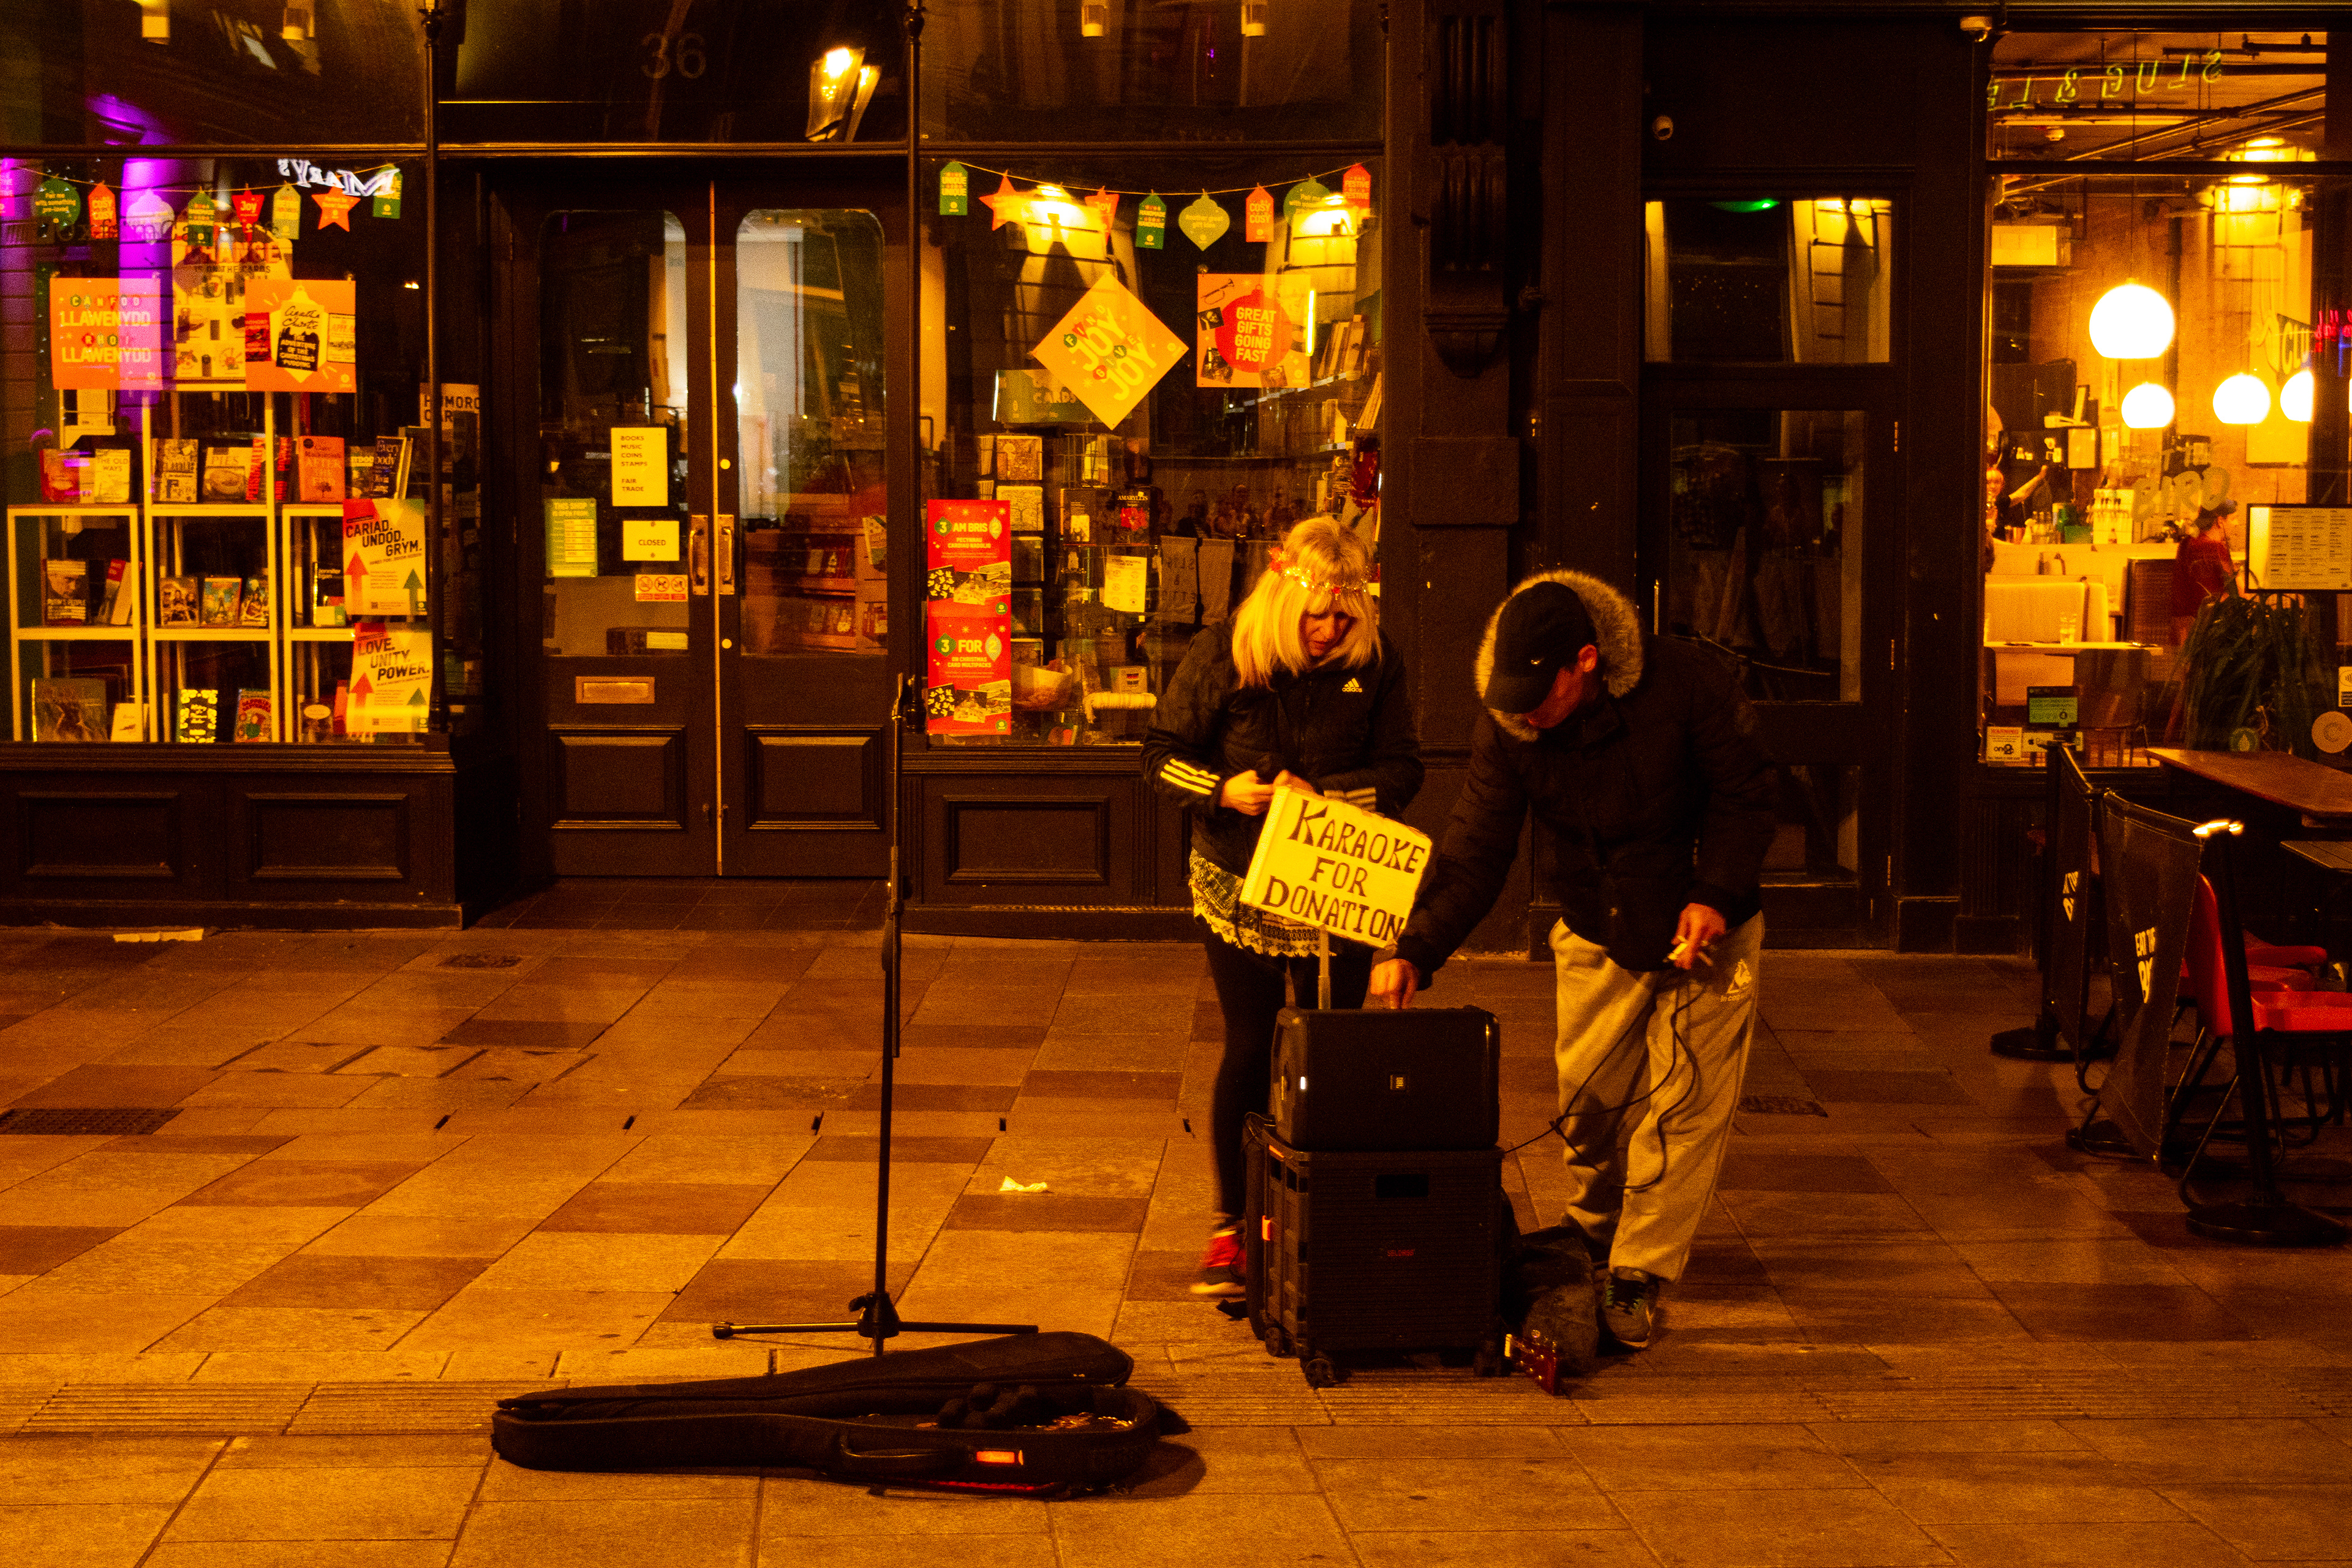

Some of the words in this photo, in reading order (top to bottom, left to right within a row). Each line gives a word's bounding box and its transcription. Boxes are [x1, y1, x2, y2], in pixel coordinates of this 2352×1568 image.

[641, 33, 706, 78] 36
[240, 201, 257, 213] Joy
[1096, 201, 1111, 213] Joy
[1249, 203, 1271, 212] COSY
[1249, 214, 1270, 224] COSY
[61, 311, 151, 326] LLAWENYDD
[1236, 307, 1276, 323] GREAT
[1065, 304, 1106, 347] FIND
[1237, 320, 1273, 336] GIFTS
[1069, 307, 1126, 371] JOY
[1234, 334, 1272, 350] GOING
[62, 347, 152, 363] LLAWENYDD
[1096, 334, 1137, 377] GIVE
[1235, 347, 1268, 363] FAST
[1100, 337, 1157, 401] JOY
[345, 519, 393, 538] CARIAD.
[939, 522, 948, 533] 3
[952, 522, 967, 532] AM
[968, 522, 988, 532] BRIS
[992, 522, 1000, 533] 2
[362, 530, 404, 548] UNDOD.
[386, 540, 422, 556] GRYM.
[358, 638, 395, 656] LOVE.
[941, 639, 949, 653] 3
[958, 639, 982, 653] FOR
[988, 639, 997, 653] 2
[371, 649, 410, 668] UNITY.
[377, 660, 429, 680] POWER.
[1287, 799, 1426, 874] KARAOKE
[1309, 856, 1368, 897] FOR
[1261, 875, 1405, 943] DONATION
